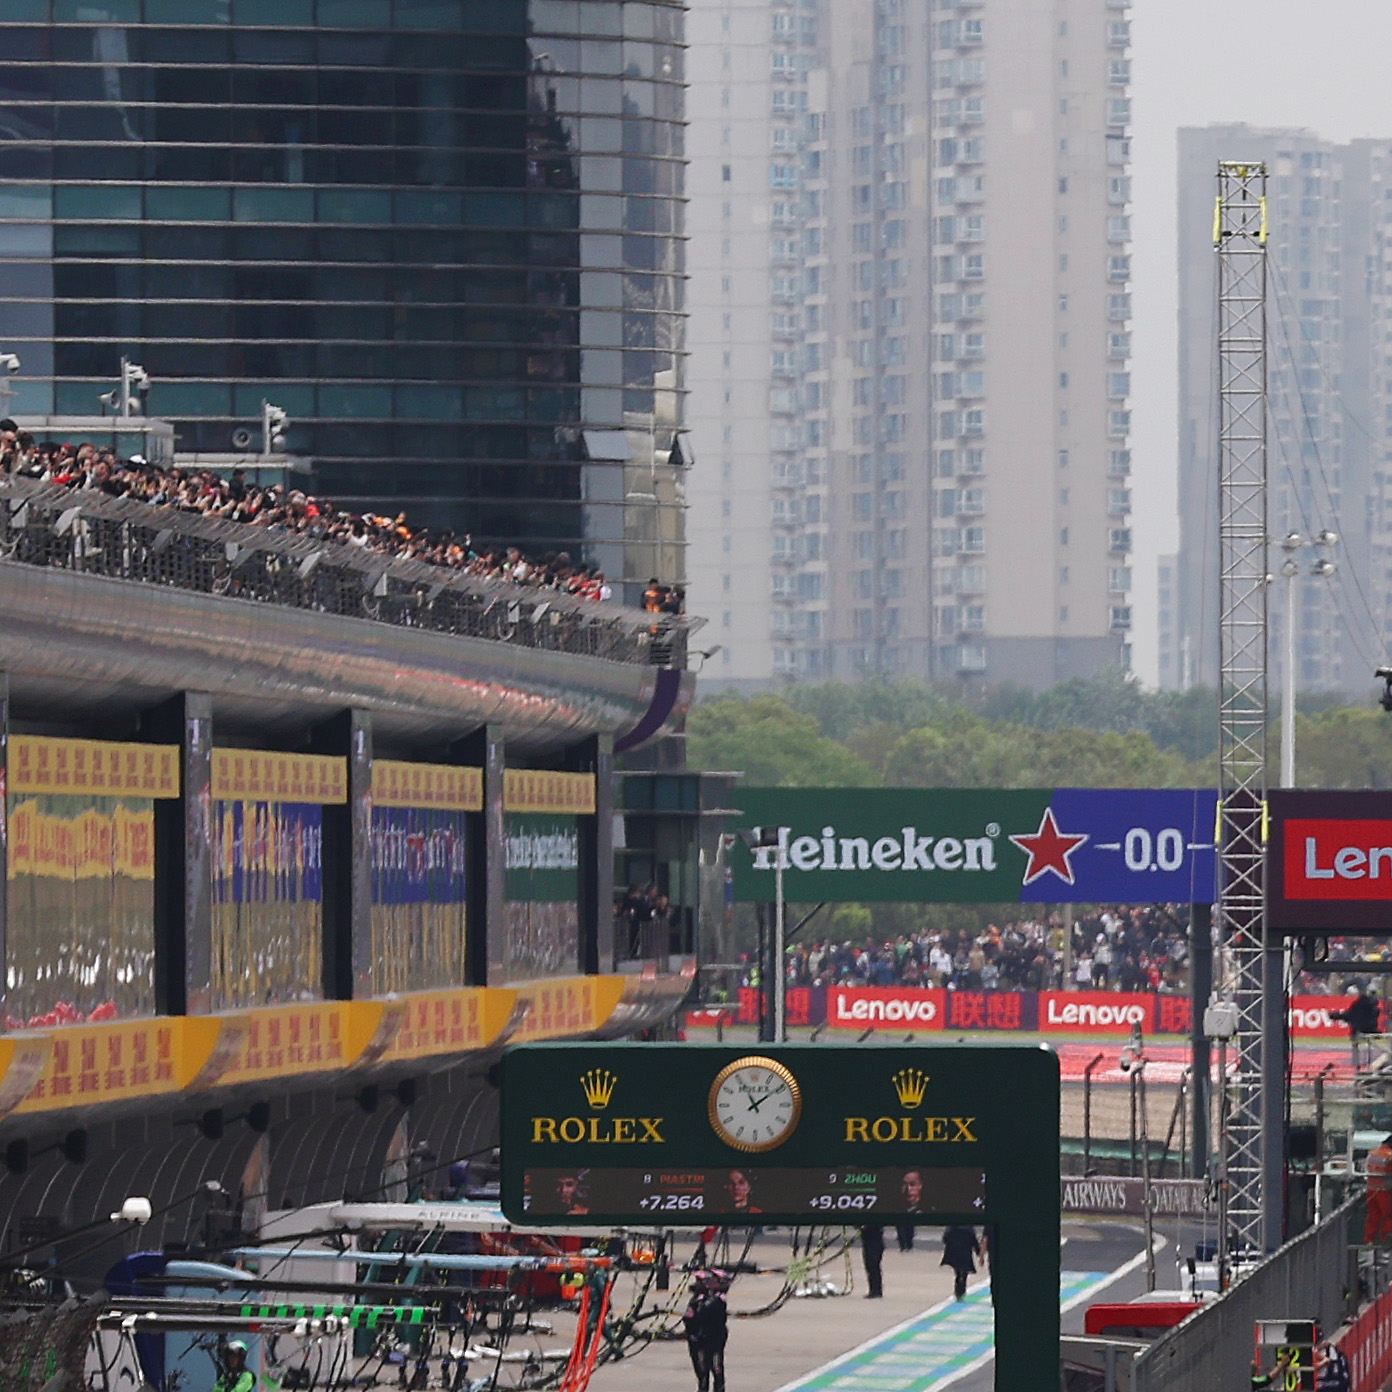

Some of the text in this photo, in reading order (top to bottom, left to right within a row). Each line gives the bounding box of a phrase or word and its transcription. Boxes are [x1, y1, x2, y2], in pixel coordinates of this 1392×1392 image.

[752, 826, 998, 871] Heineken
[837, 994, 937, 1021] Lenovo
[951, 991, 1022, 1030] 联想
[1048, 998, 1145, 1026] Lenovo
[531, 1117, 667, 1145] ROLEX
[844, 1117, 978, 1144] ROLEX
[828, 1173, 877, 1184] 9 ZHOU
[639, 1195, 705, 1210] +7.264
[809, 1195, 877, 1210] +9.047
[1062, 1182, 1126, 1210] AIRWAYS
